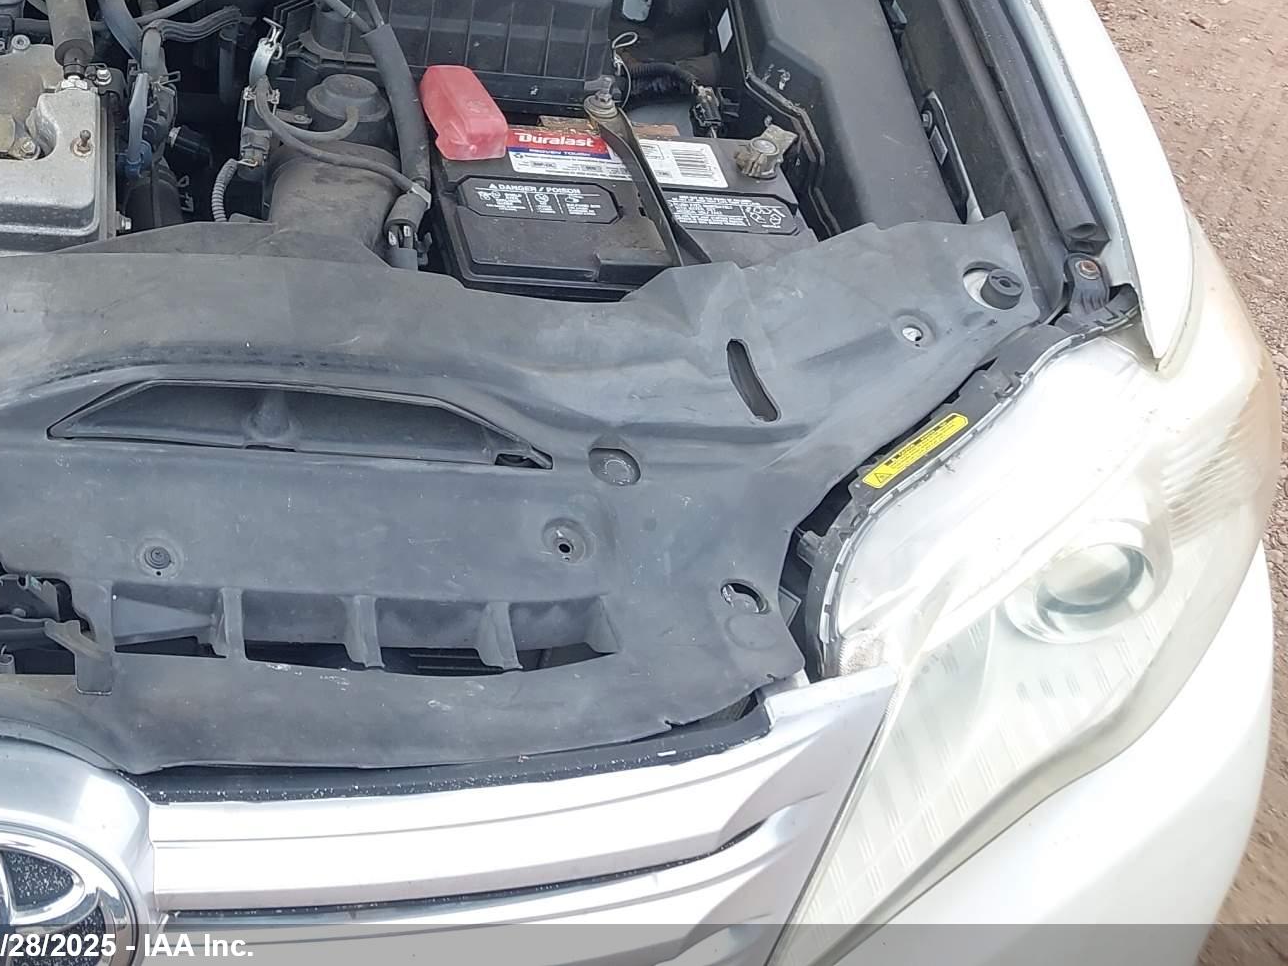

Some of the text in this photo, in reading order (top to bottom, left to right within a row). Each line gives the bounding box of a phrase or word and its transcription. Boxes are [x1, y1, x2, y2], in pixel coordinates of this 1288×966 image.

[514, 132, 595, 147] Duralast
[498, 184, 538, 192] DANGER
[546, 186, 581, 194] POISON
